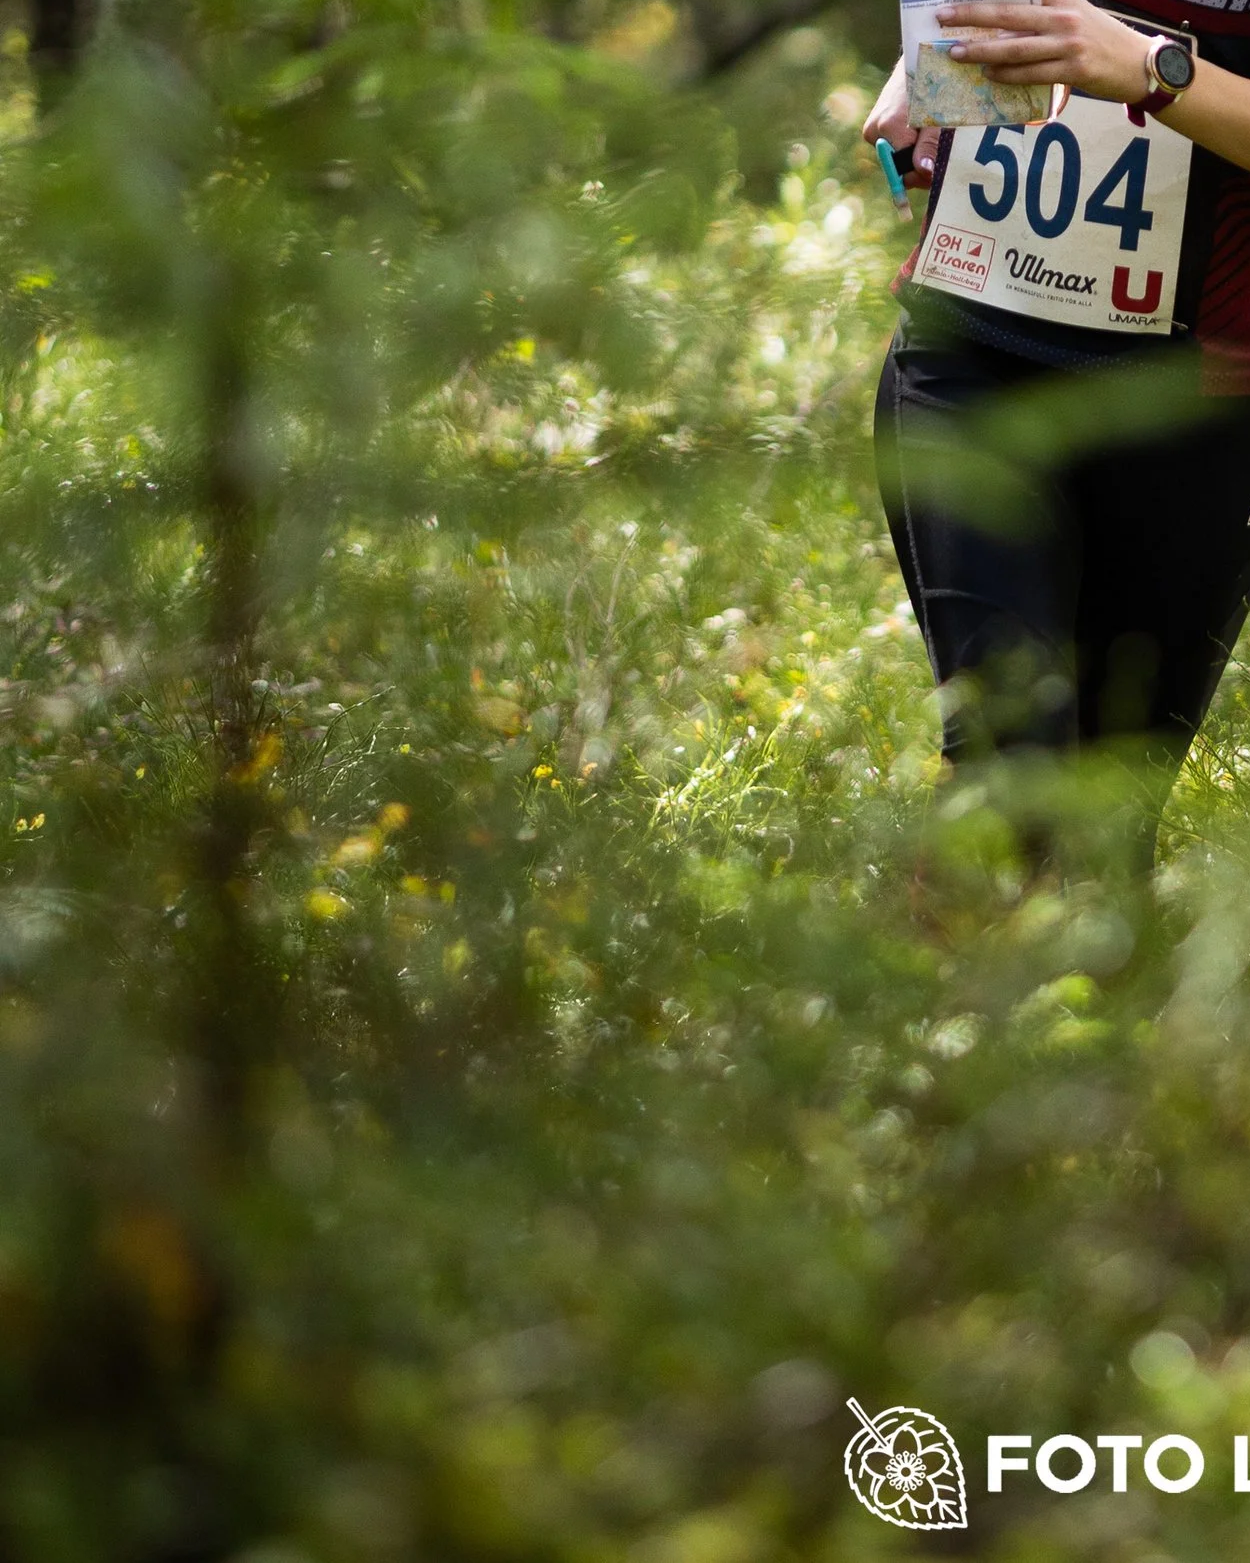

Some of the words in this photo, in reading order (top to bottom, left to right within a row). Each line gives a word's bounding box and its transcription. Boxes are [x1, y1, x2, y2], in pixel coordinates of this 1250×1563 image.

[968, 122, 1153, 251] 504
[934, 248, 986, 275] Tisaren
[1005, 248, 1096, 294] Ullmax
[1108, 313, 1157, 326] UMARA
